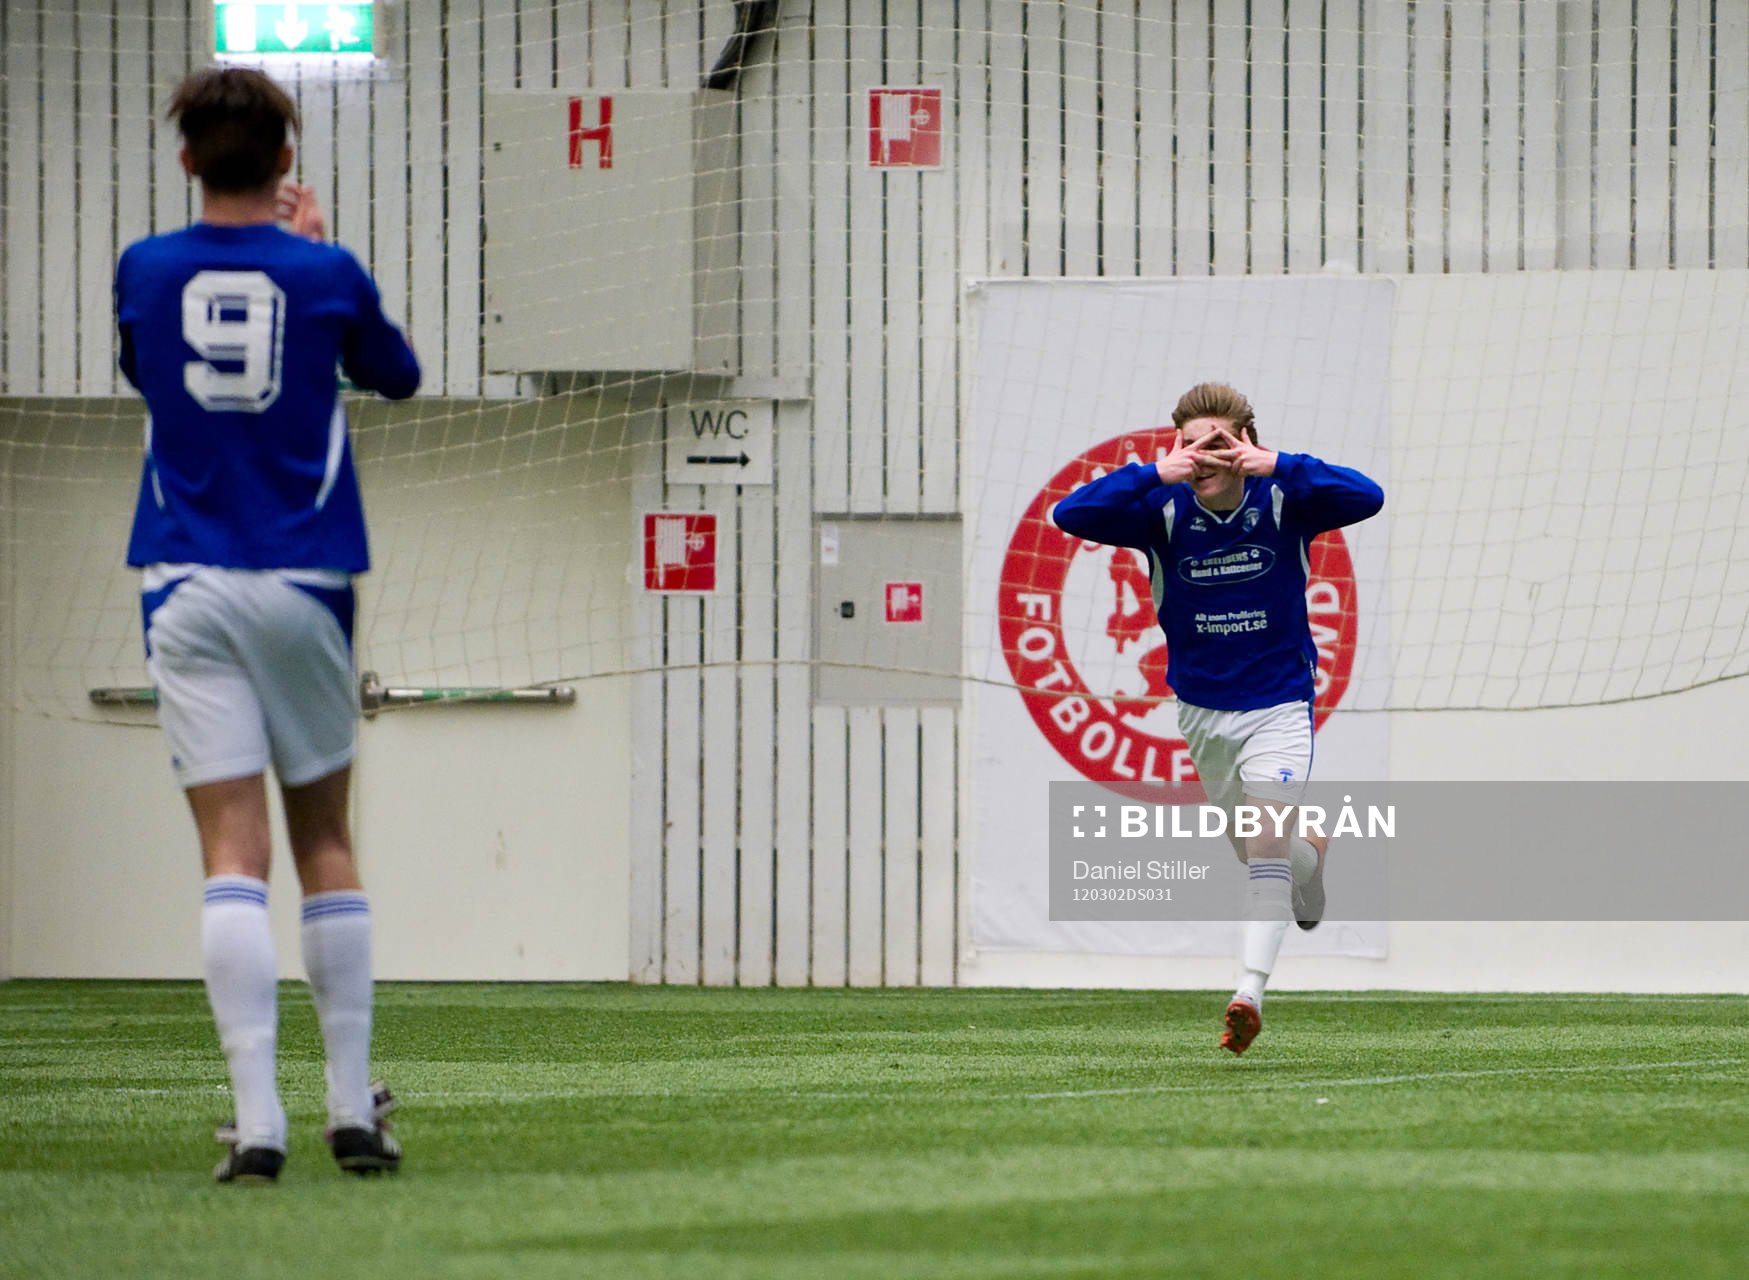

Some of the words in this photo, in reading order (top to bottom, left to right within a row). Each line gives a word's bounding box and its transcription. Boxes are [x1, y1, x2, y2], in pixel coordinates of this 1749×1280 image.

[568, 96, 613, 170] H
[181, 270, 286, 413] 9
[690, 410, 749, 440] WC
[1196, 619, 1268, 637] x-import.se
